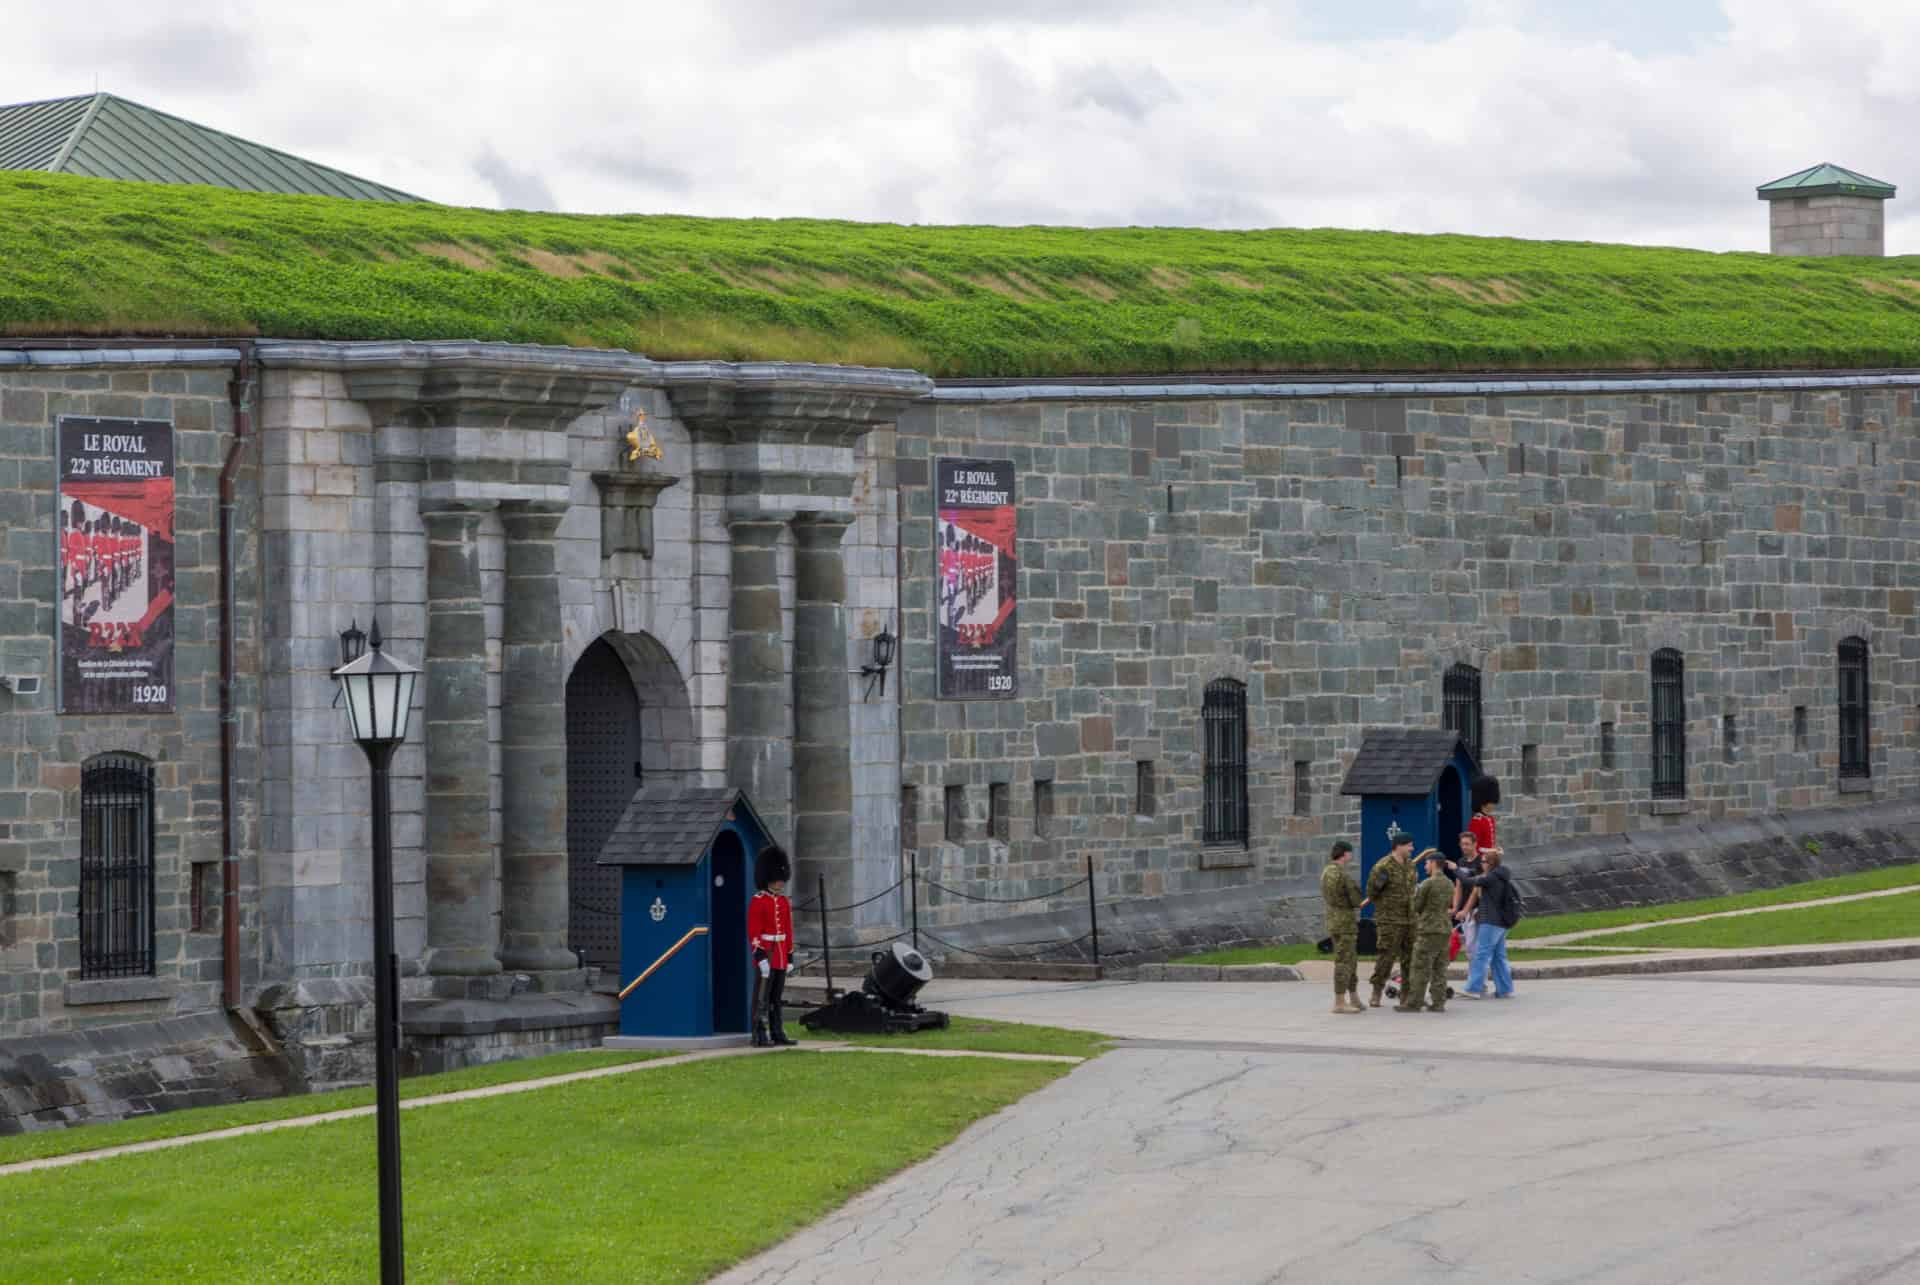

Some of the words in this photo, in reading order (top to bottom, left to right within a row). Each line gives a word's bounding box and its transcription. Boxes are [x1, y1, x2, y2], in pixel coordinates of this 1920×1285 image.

[83, 433, 100, 452] LE
[102, 434, 146, 453] ROYAL
[93, 456, 163, 476] RÉGIMENT
[953, 470, 965, 484] LE
[966, 471, 997, 486] ROYAL
[960, 487, 1008, 504] RÉGIMENT
[991, 675, 1012, 690] 1920
[136, 685, 167, 703] 1920
